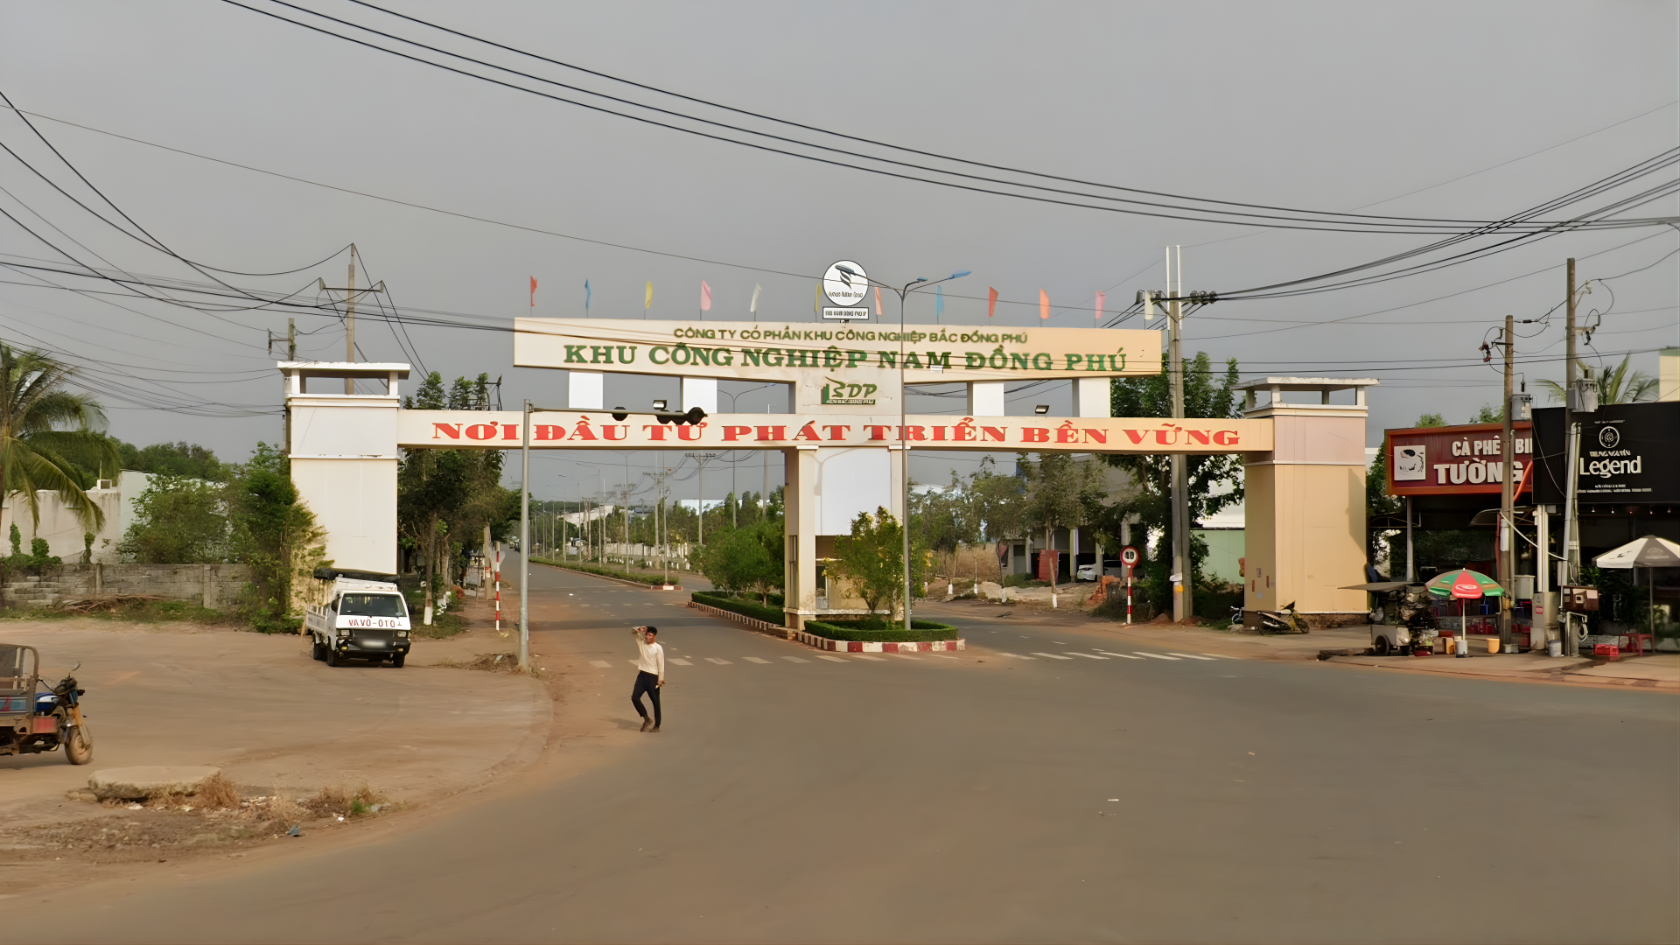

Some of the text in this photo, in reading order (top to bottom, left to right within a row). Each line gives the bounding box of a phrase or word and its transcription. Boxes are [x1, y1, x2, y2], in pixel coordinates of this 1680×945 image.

[674, 327, 715, 339] CÔNG
[718, 329, 737, 339] TY
[804, 331, 833, 341] KHU
[835, 329, 875, 341] CÔNG
[563, 342, 1127, 372] KHU CÔNG NGHIỆP NAM ĐỒNG PHÚ
[432, 421, 520, 440] NƠI
[533, 415, 630, 441] ĐẦU
[721, 420, 850, 441] PHÁT
[863, 417, 1008, 442] TRIỂN
[1020, 420, 1109, 444] BỀN
[1122, 423, 1240, 445] VỮNG
[1452, 437, 1471, 457] CÀ
[1473, 435, 1502, 455] PHÊ
[1579, 455, 1642, 478] Legend
